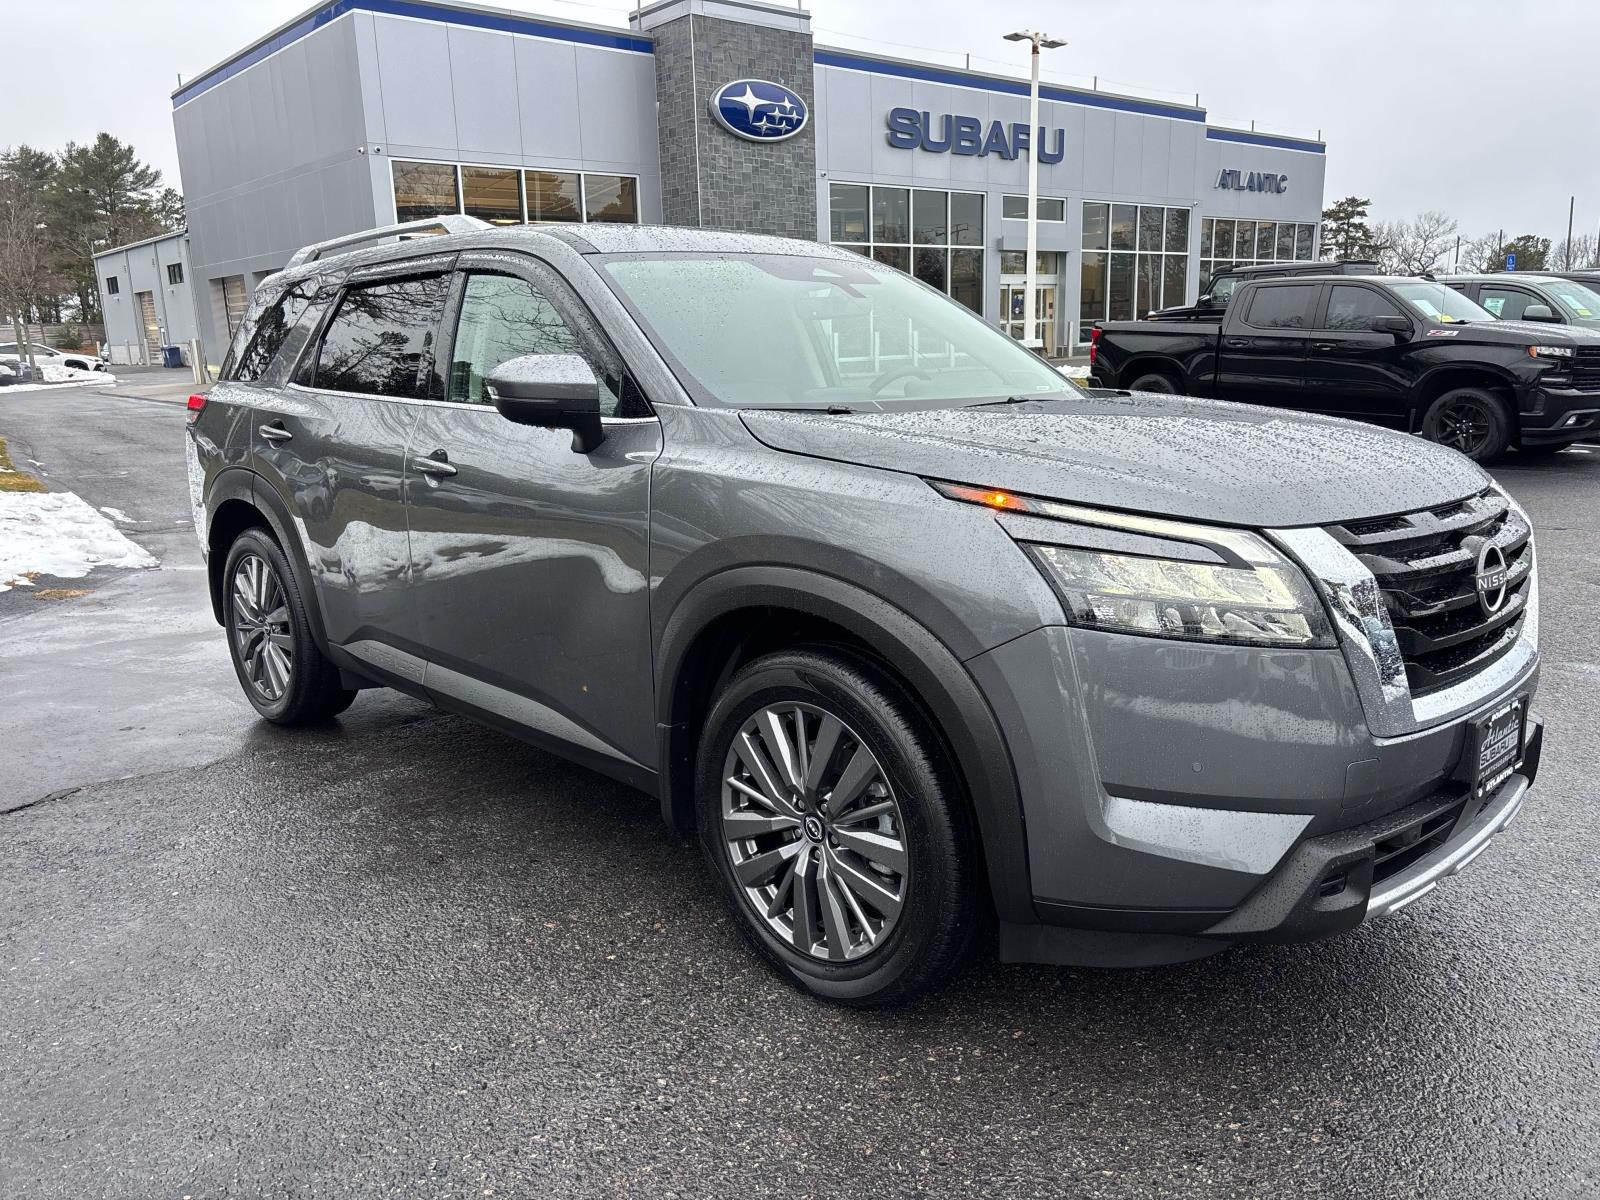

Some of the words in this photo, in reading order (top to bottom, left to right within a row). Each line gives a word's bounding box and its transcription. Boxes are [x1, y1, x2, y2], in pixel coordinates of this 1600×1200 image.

[885, 106, 1065, 165] SUBARU
[1214, 168, 1288, 194] ATLANTIC
[1478, 571, 1506, 590] NISS
[1481, 714, 1519, 752] Atlantic
[1481, 738, 1510, 767] SUBARU
